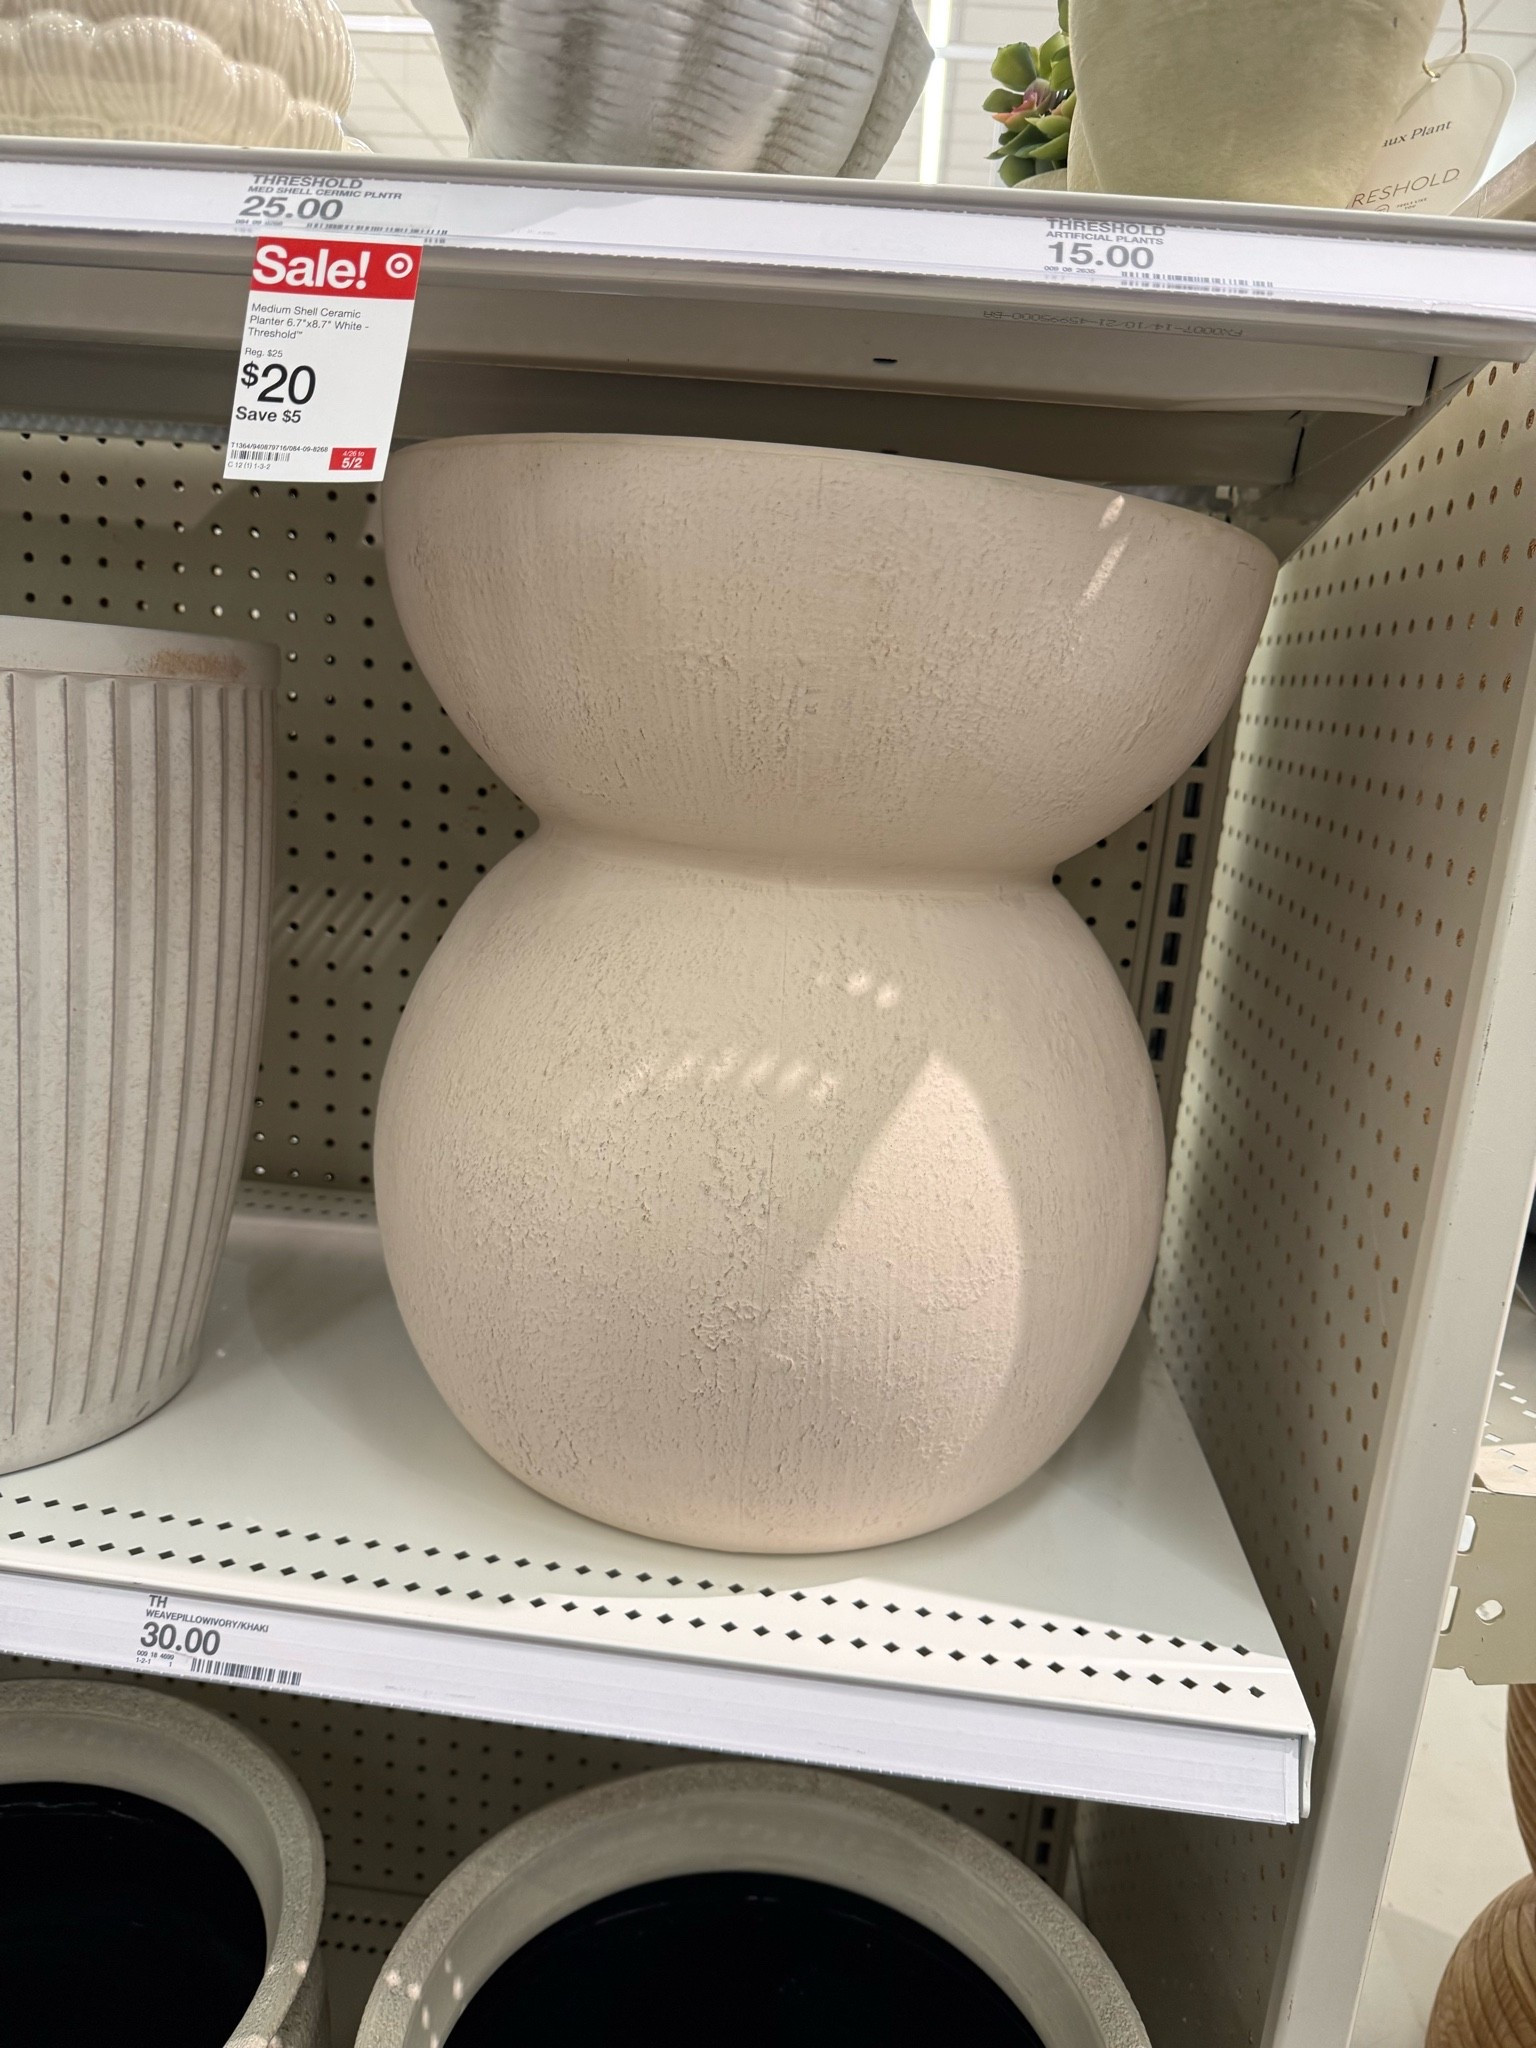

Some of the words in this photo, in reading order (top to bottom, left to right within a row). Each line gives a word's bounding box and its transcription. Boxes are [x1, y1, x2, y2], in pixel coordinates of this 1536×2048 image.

[1411, 121, 1452, 140] Plant
[253, 174, 363, 189] THRESHOLD
[1346, 168, 1460, 209] RESHOLD
[248, 185, 274, 194] MED
[276, 187, 313, 196] SHELL
[315, 189, 362, 198] CERMIC
[363, 191, 402, 200] PLNTR
[239, 195, 343, 220] 25.00
[1046, 219, 1166, 237] THRESHOLD
[1045, 231, 1113, 242] ARTIFICIAL
[1116, 234, 1164, 246] PLANTS
[1048, 241, 1154, 269] 15.00
[252, 244, 371, 290] Sale!
[251, 303, 291, 314] Medium
[293, 305, 318, 317] Shell
[320, 308, 361, 319] Ceramic
[249, 315, 284, 326] Planter
[334, 320, 362, 331] White
[244, 347, 265, 358] Reg.
[267, 349, 283, 358] $25
[240, 360, 316, 405] $20
[235, 406, 277, 422] Save
[282, 409, 302, 424] $5
[341, 457, 362, 469] 5/2
[149, 1594, 168, 1609] TH
[146, 1609, 269, 1633] WEAVEPILLOWIVORY/KHAKI
[140, 1621, 221, 1656] 30.00
